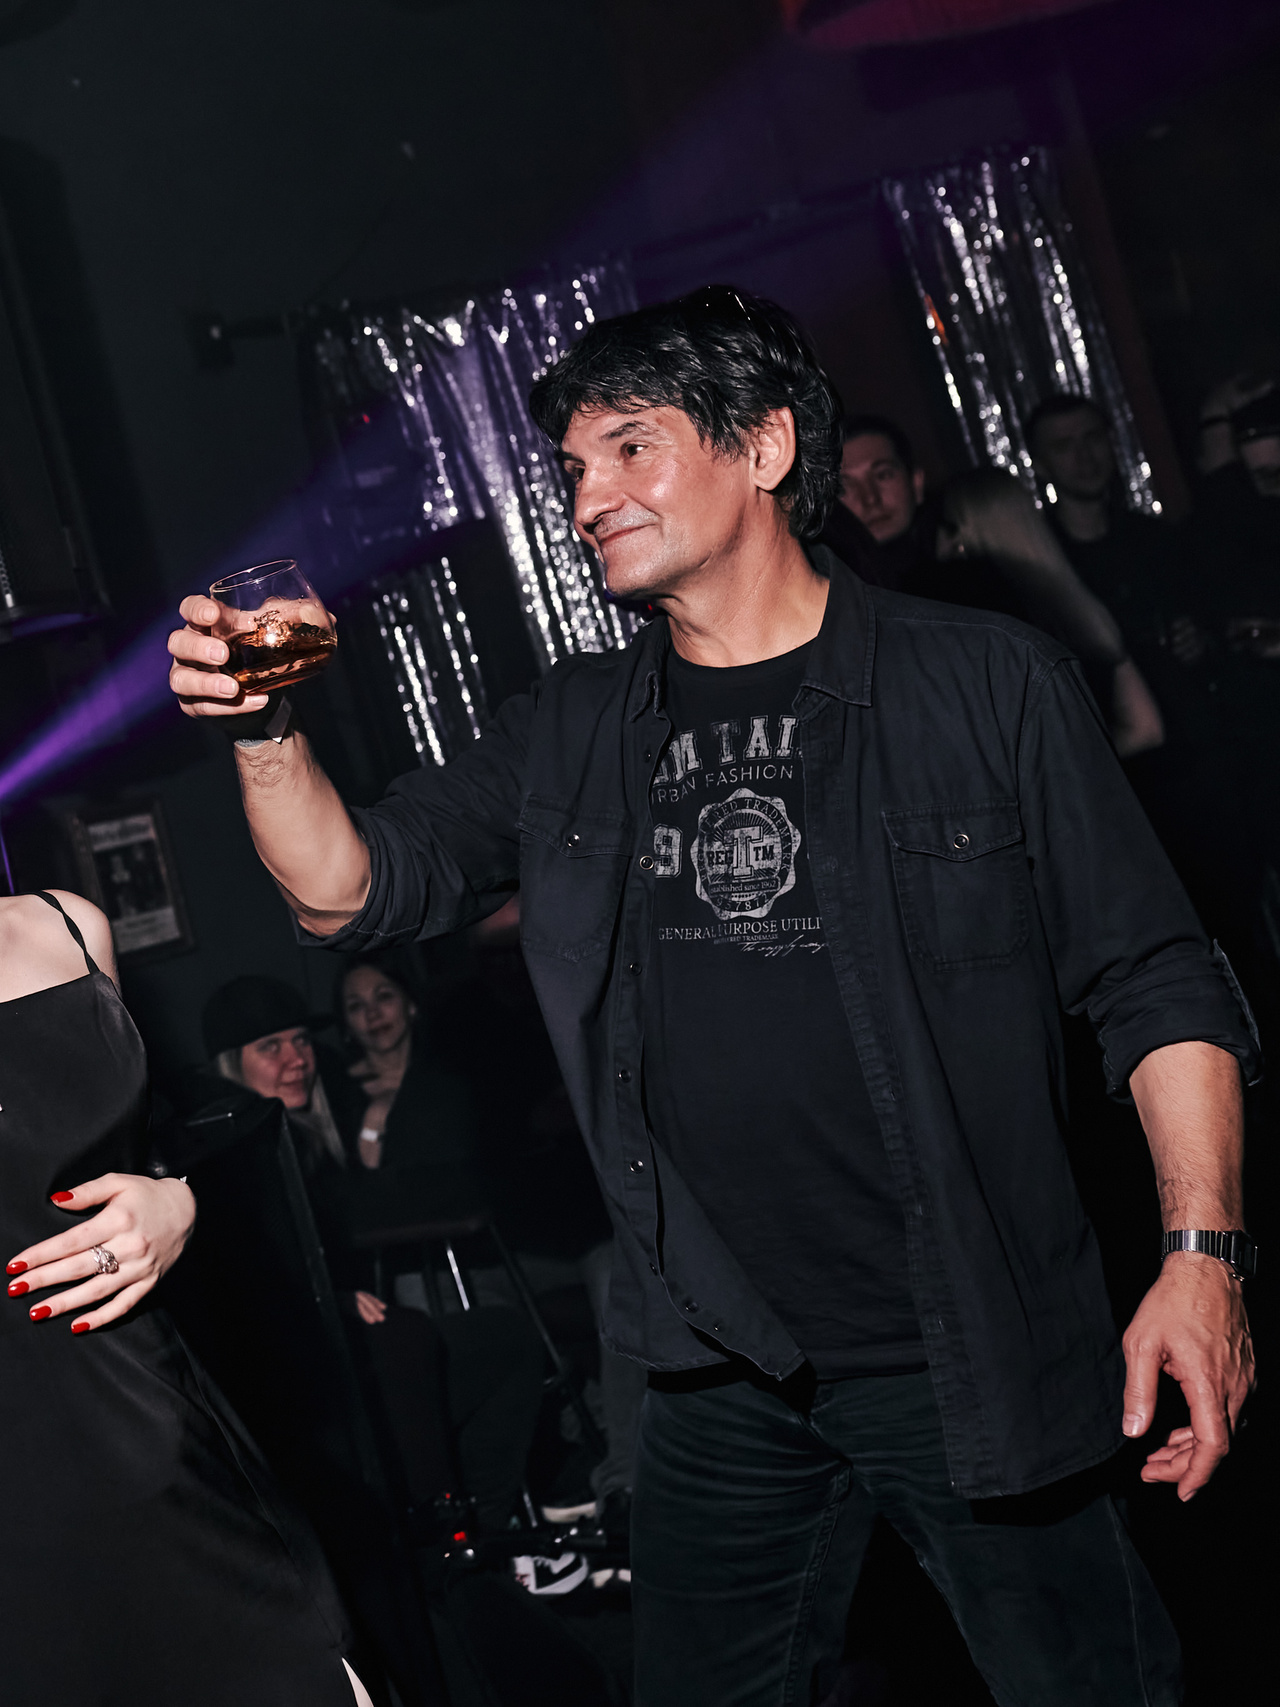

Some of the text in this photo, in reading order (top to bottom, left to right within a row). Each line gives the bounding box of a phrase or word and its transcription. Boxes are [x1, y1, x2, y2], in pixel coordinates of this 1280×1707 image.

[710, 714, 804, 766] TAI
[704, 764, 794, 788] FASHION
[753, 844, 775, 862] TM
[658, 925, 717, 941] GENERAL
[781, 917, 823, 932] UTILI
